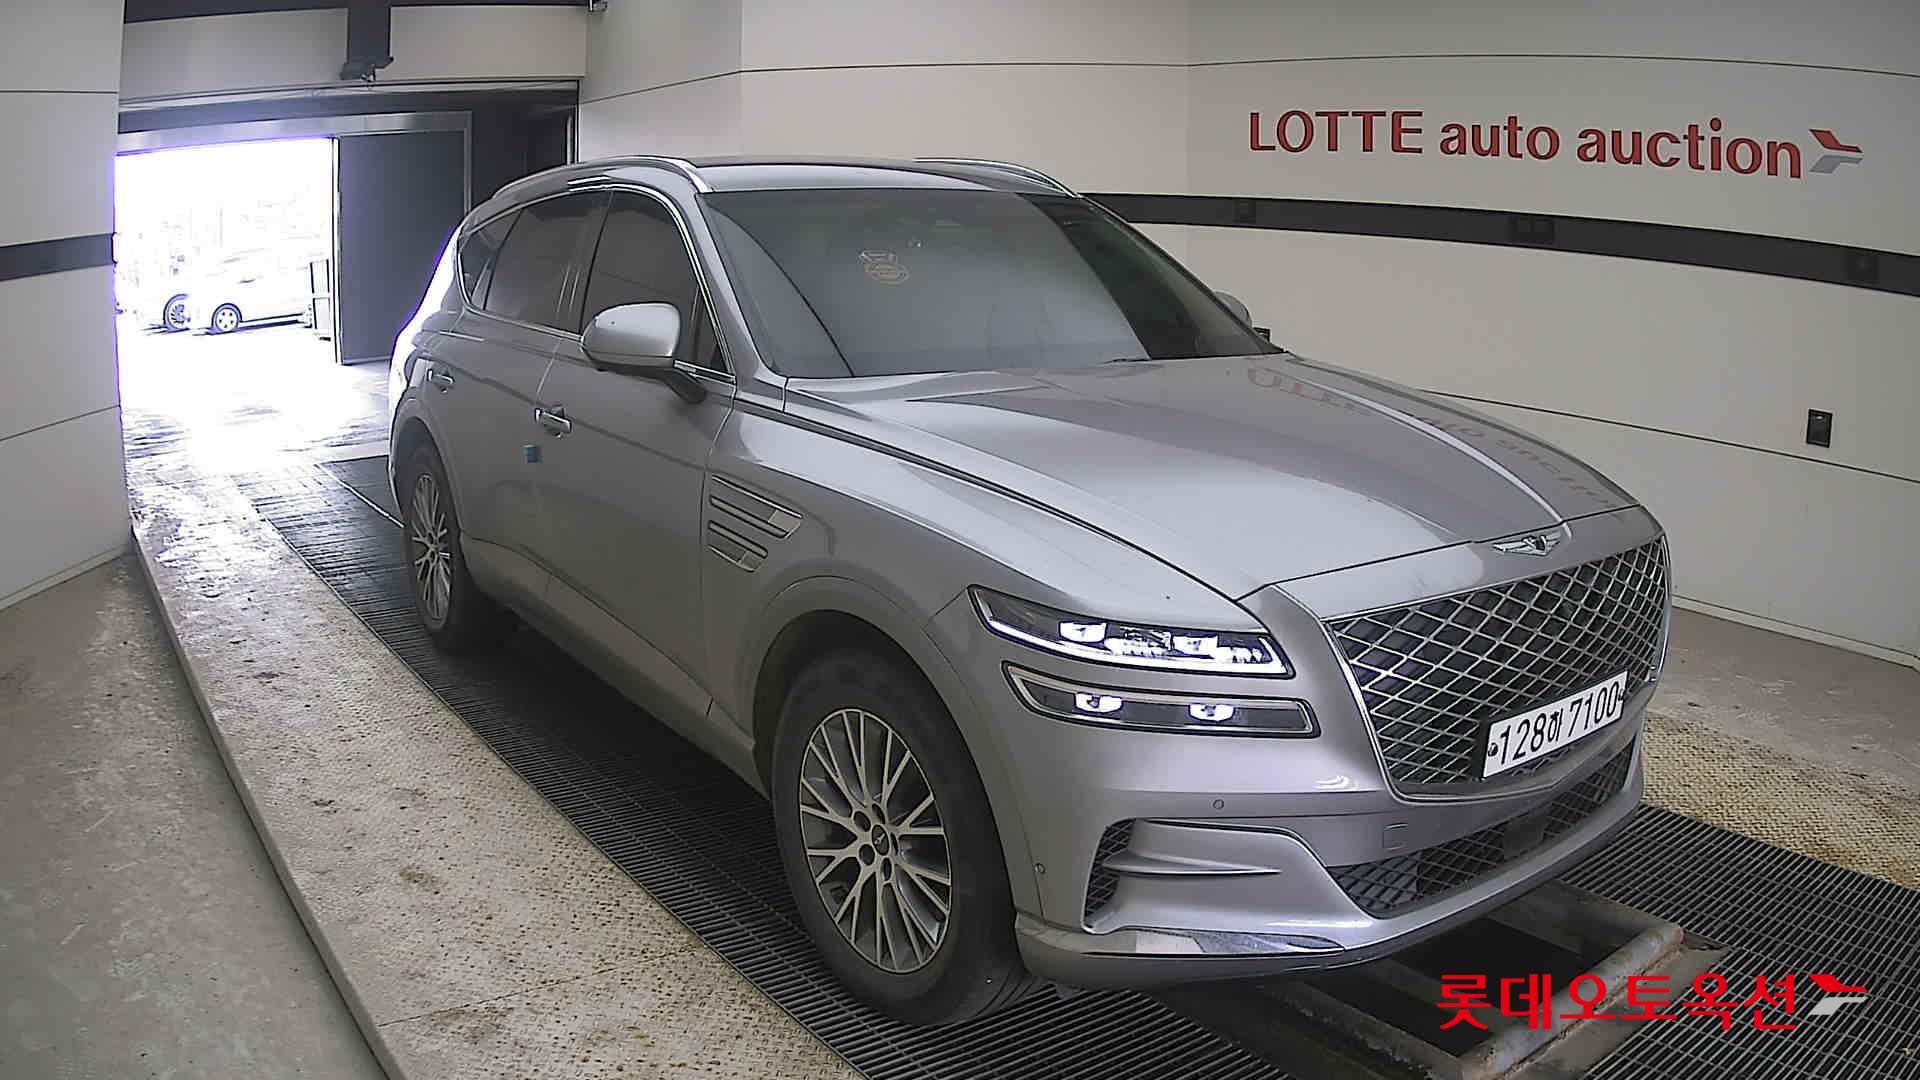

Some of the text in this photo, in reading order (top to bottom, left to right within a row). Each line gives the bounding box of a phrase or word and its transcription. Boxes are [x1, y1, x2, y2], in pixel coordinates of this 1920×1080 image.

[1249, 110, 1802, 179] LOTTE auto auction
[1567, 681, 1620, 738] 7100
